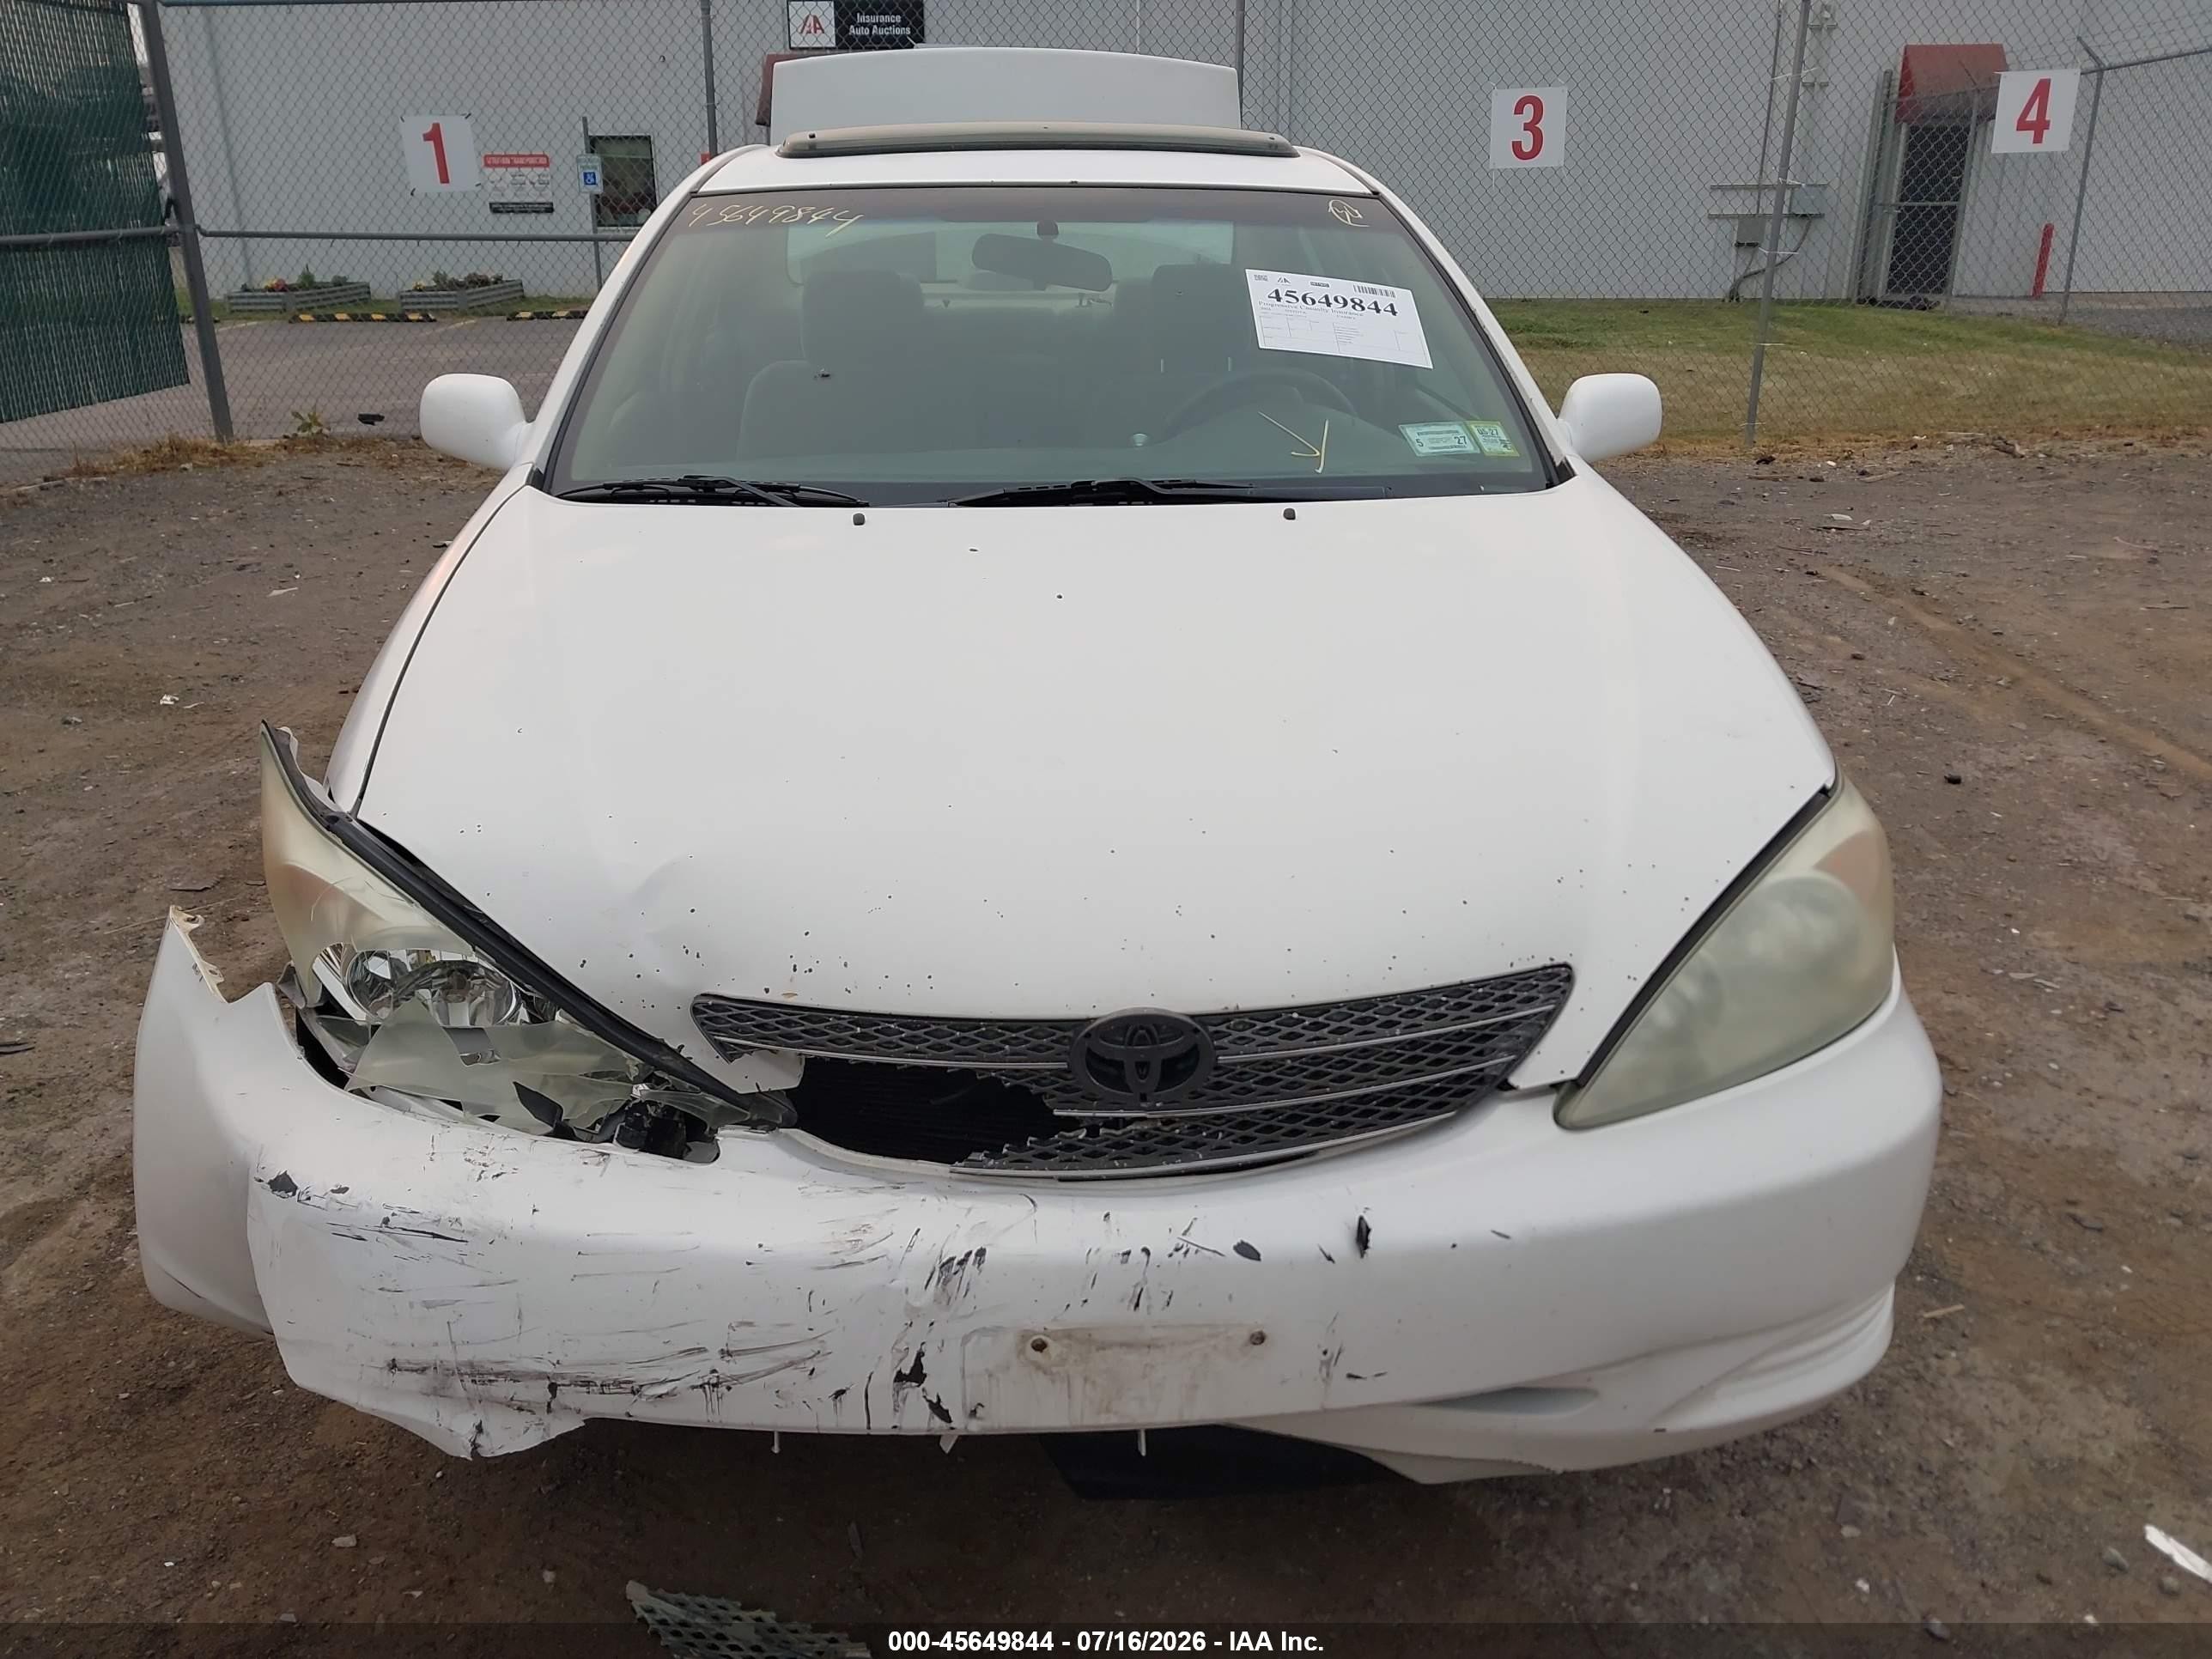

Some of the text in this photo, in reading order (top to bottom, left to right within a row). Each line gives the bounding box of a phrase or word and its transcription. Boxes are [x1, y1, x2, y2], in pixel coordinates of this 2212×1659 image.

[848, 25, 911, 35] Auto Auctions
[856, 13, 902, 23] Insurance
[2015, 78, 2052, 145] 4
[1511, 94, 1545, 161] 3
[422, 122, 450, 184] 1
[688, 204, 865, 238] 45649844
[1258, 301, 1298, 310] Progressive
[1331, 308, 1364, 317] Insurance
[1267, 288, 1399, 317] 45649844
[1415, 439, 1424, 447] 5
[1454, 435, 1468, 445] 27
